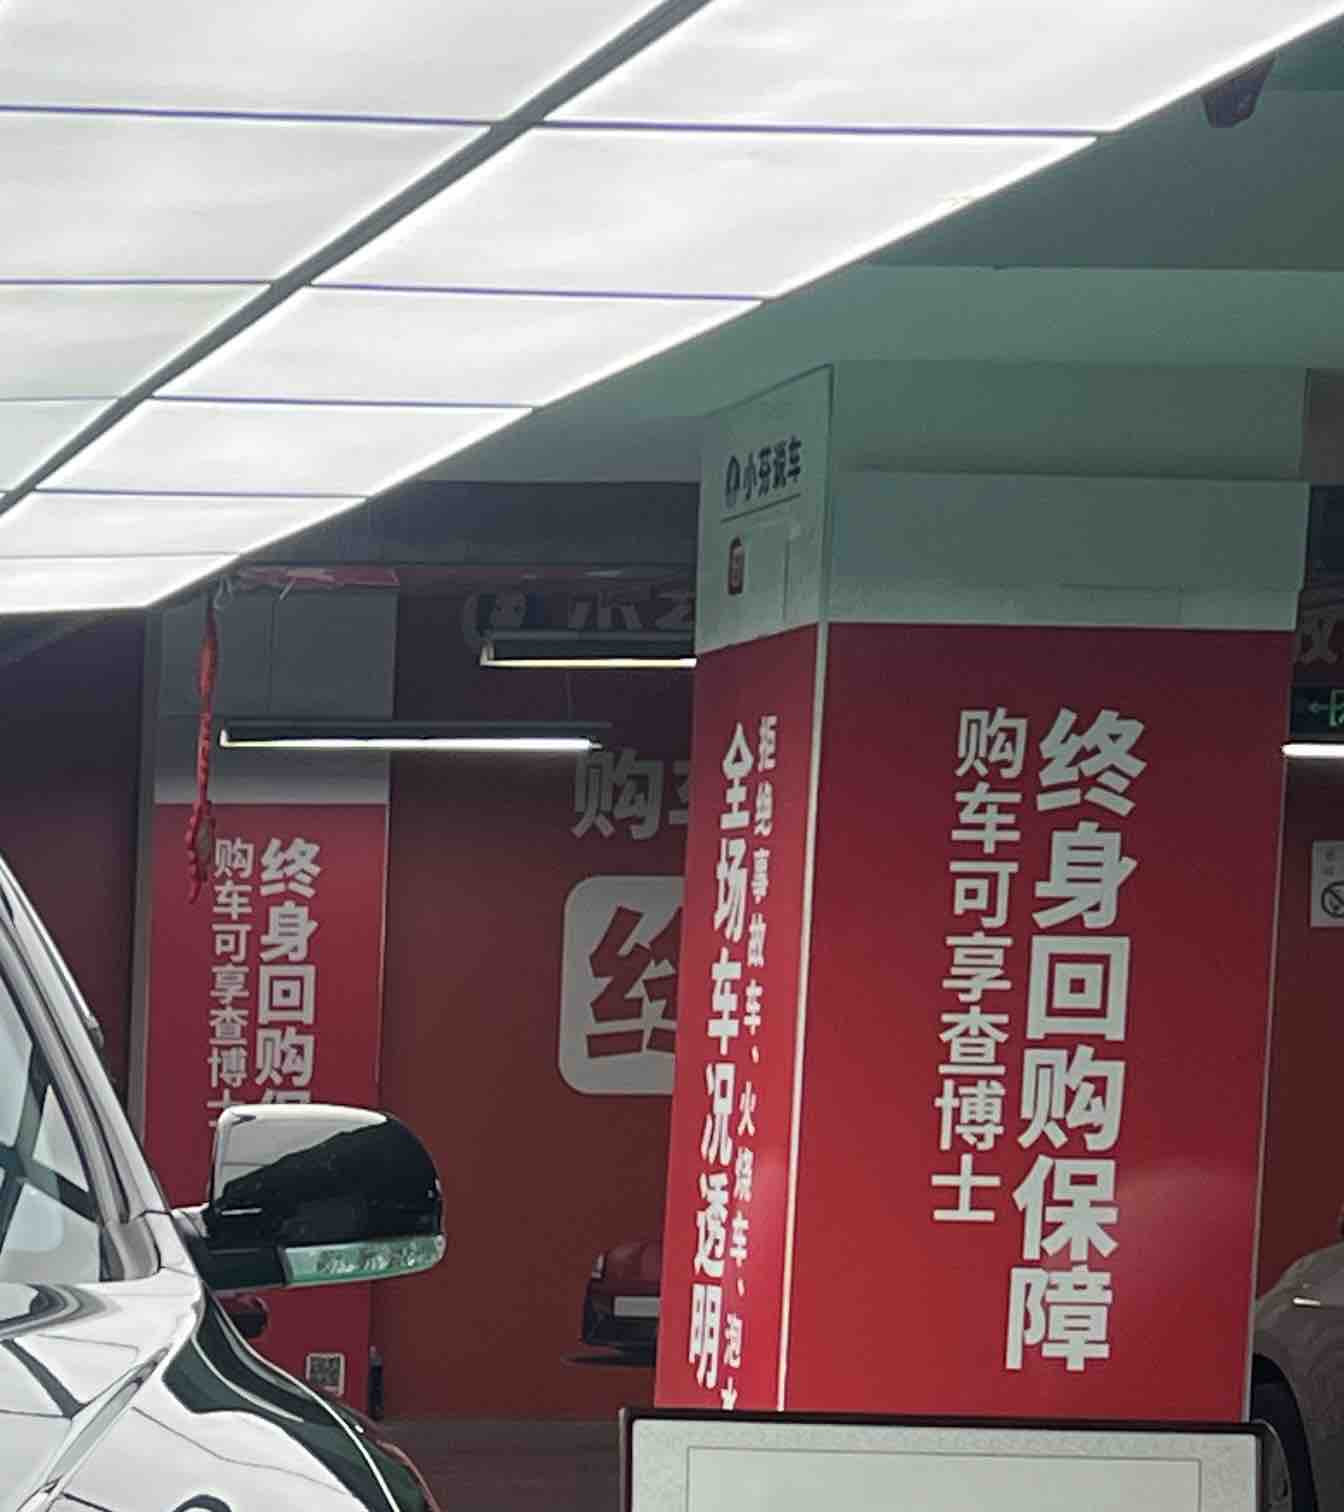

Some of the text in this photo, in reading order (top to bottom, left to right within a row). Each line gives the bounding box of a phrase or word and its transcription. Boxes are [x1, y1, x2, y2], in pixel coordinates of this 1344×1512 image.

[573, 750, 688, 840] 购
[689, 721, 754, 1389] 全场车况透明
[932, 707, 1027, 1222] 购车可享查博士
[1006, 708, 1147, 1371] 终身回购保障
